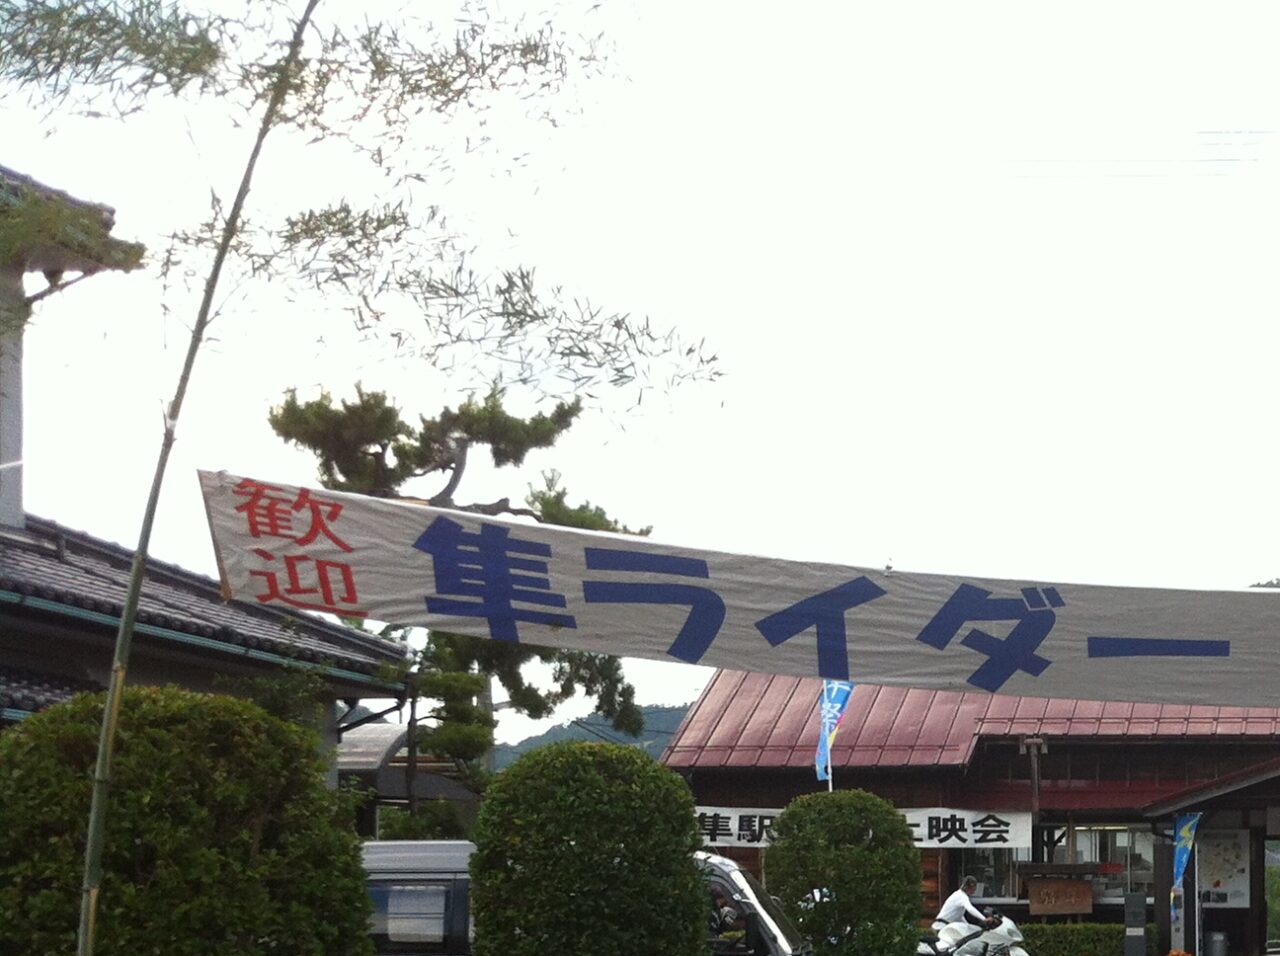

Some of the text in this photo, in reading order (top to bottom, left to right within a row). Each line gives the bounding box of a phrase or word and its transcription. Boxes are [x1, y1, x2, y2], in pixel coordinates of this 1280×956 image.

[232, 478, 369, 618] 歓迎
[413, 515, 1231, 693] 隼ライダー
